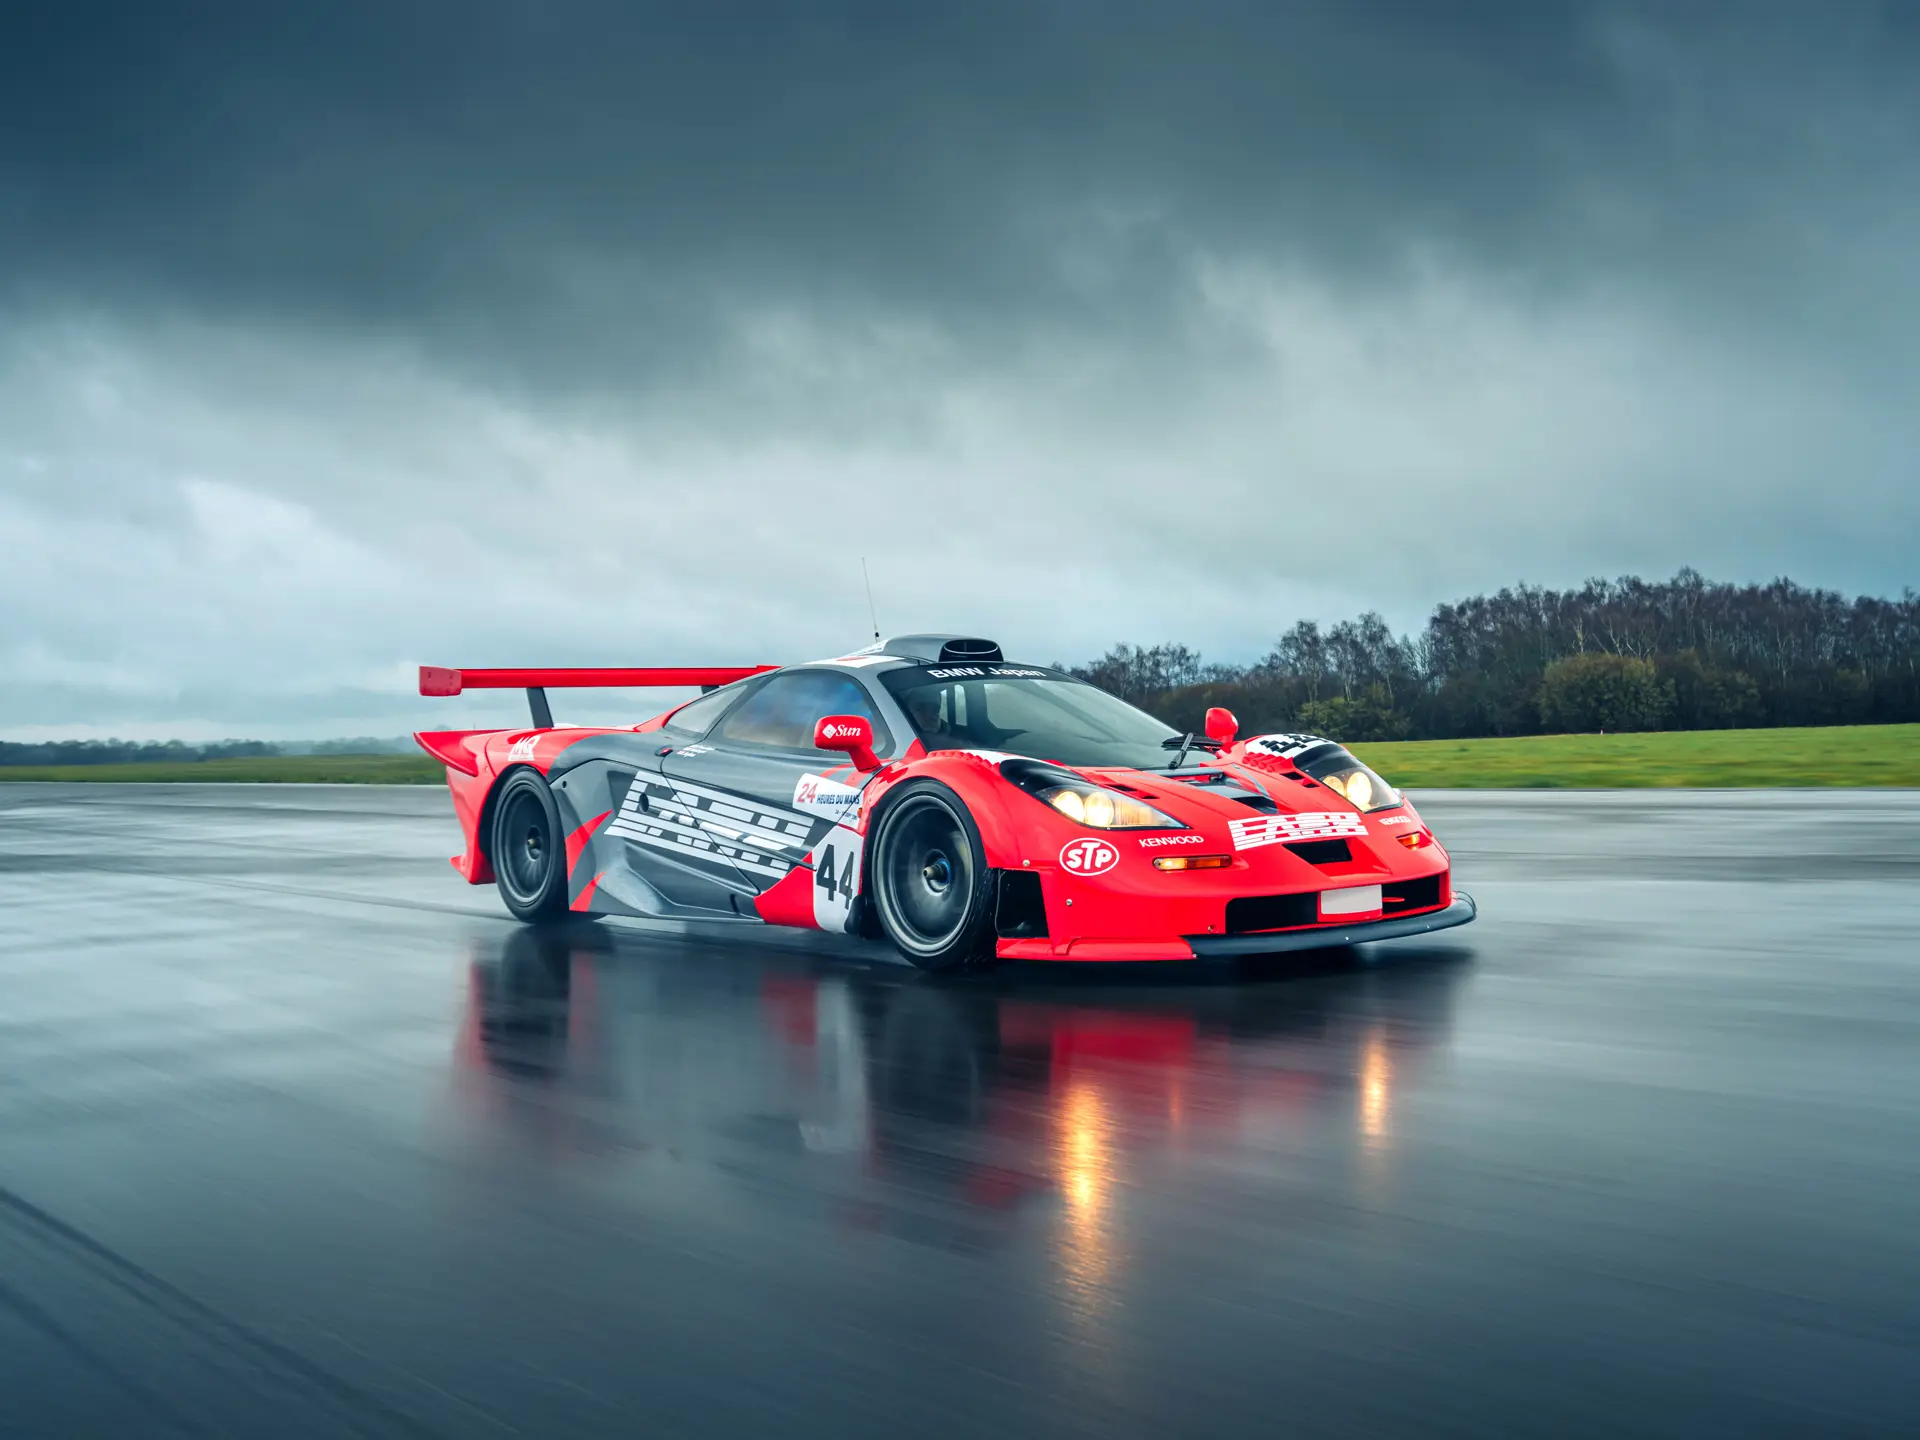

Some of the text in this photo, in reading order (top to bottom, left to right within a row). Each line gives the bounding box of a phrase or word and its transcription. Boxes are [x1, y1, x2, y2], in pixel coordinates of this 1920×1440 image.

[927, 667, 1047, 678] BMW Japan
[835, 724, 861, 737] Sun
[796, 782, 818, 804] 24
[816, 793, 836, 805] HEURES
[835, 794, 843, 805] DU
[1138, 835, 1205, 848] KENWOOD
[1066, 842, 1113, 870] STP
[816, 843, 855, 911] 44
